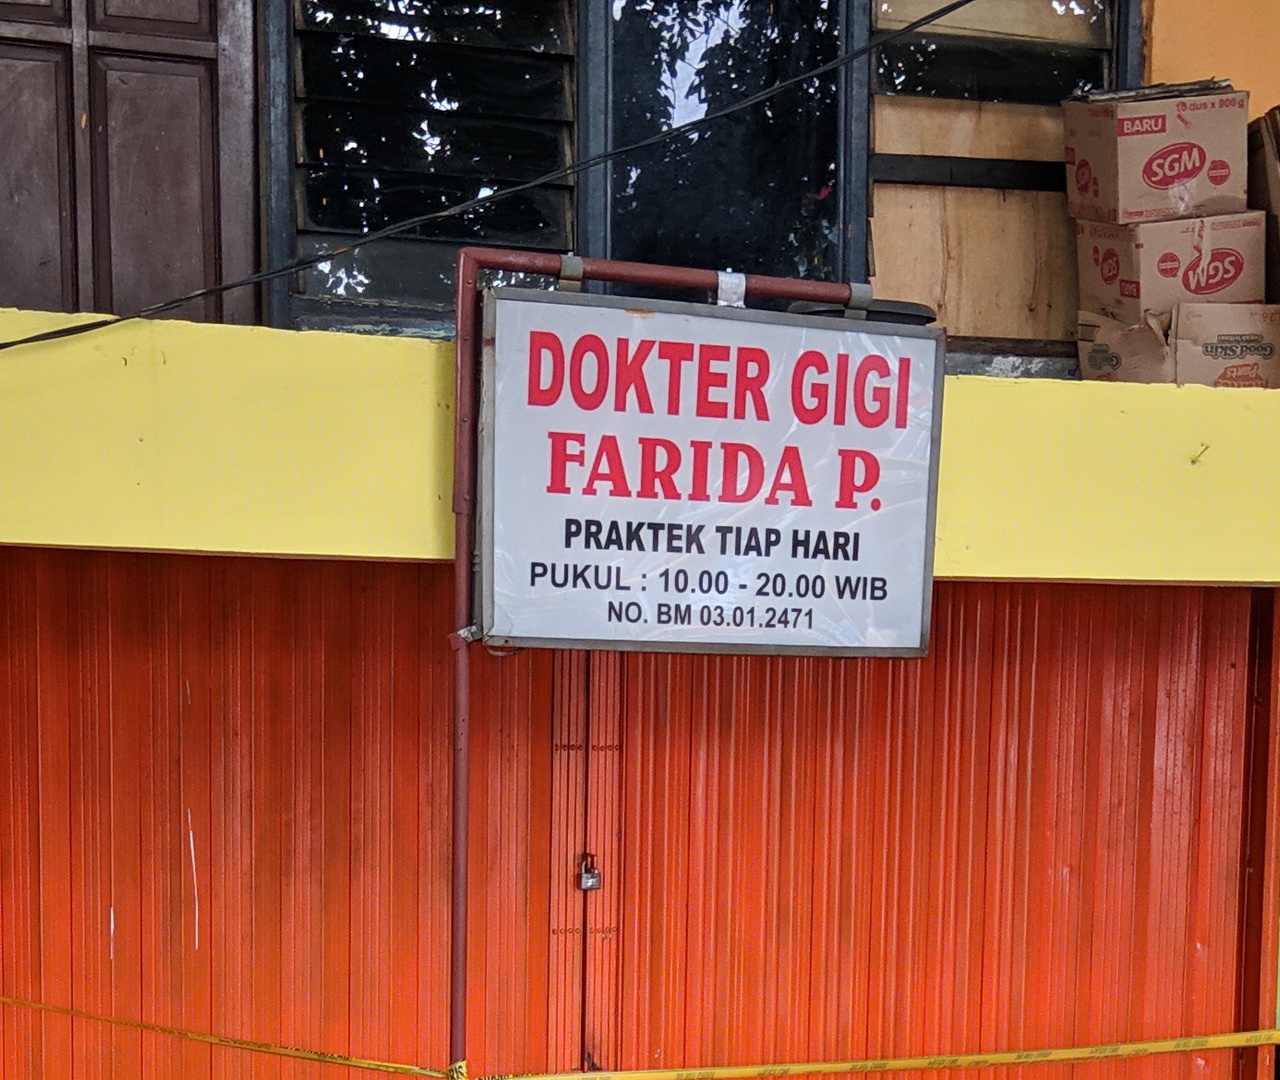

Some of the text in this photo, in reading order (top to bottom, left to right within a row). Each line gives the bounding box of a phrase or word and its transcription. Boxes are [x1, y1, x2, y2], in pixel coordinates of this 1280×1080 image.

[1123, 118, 1163, 134] BARU
[1151, 147, 1201, 182] SGM
[1187, 256, 1236, 291] SGM
[1203, 343, 1274, 359] Good Skin
[527, 330, 912, 430] DOKTER GIGI
[545, 431, 883, 511] FARIDA P.
[564, 518, 860, 562] PRAKTEK TIAP HARI
[529, 562, 631, 592] PUKUL
[658, 568, 729, 595] 10.00
[755, 573, 826, 599] 20.00
[835, 575, 889, 601] WIB
[607, 601, 814, 630] NO. BM 03.01.2471
